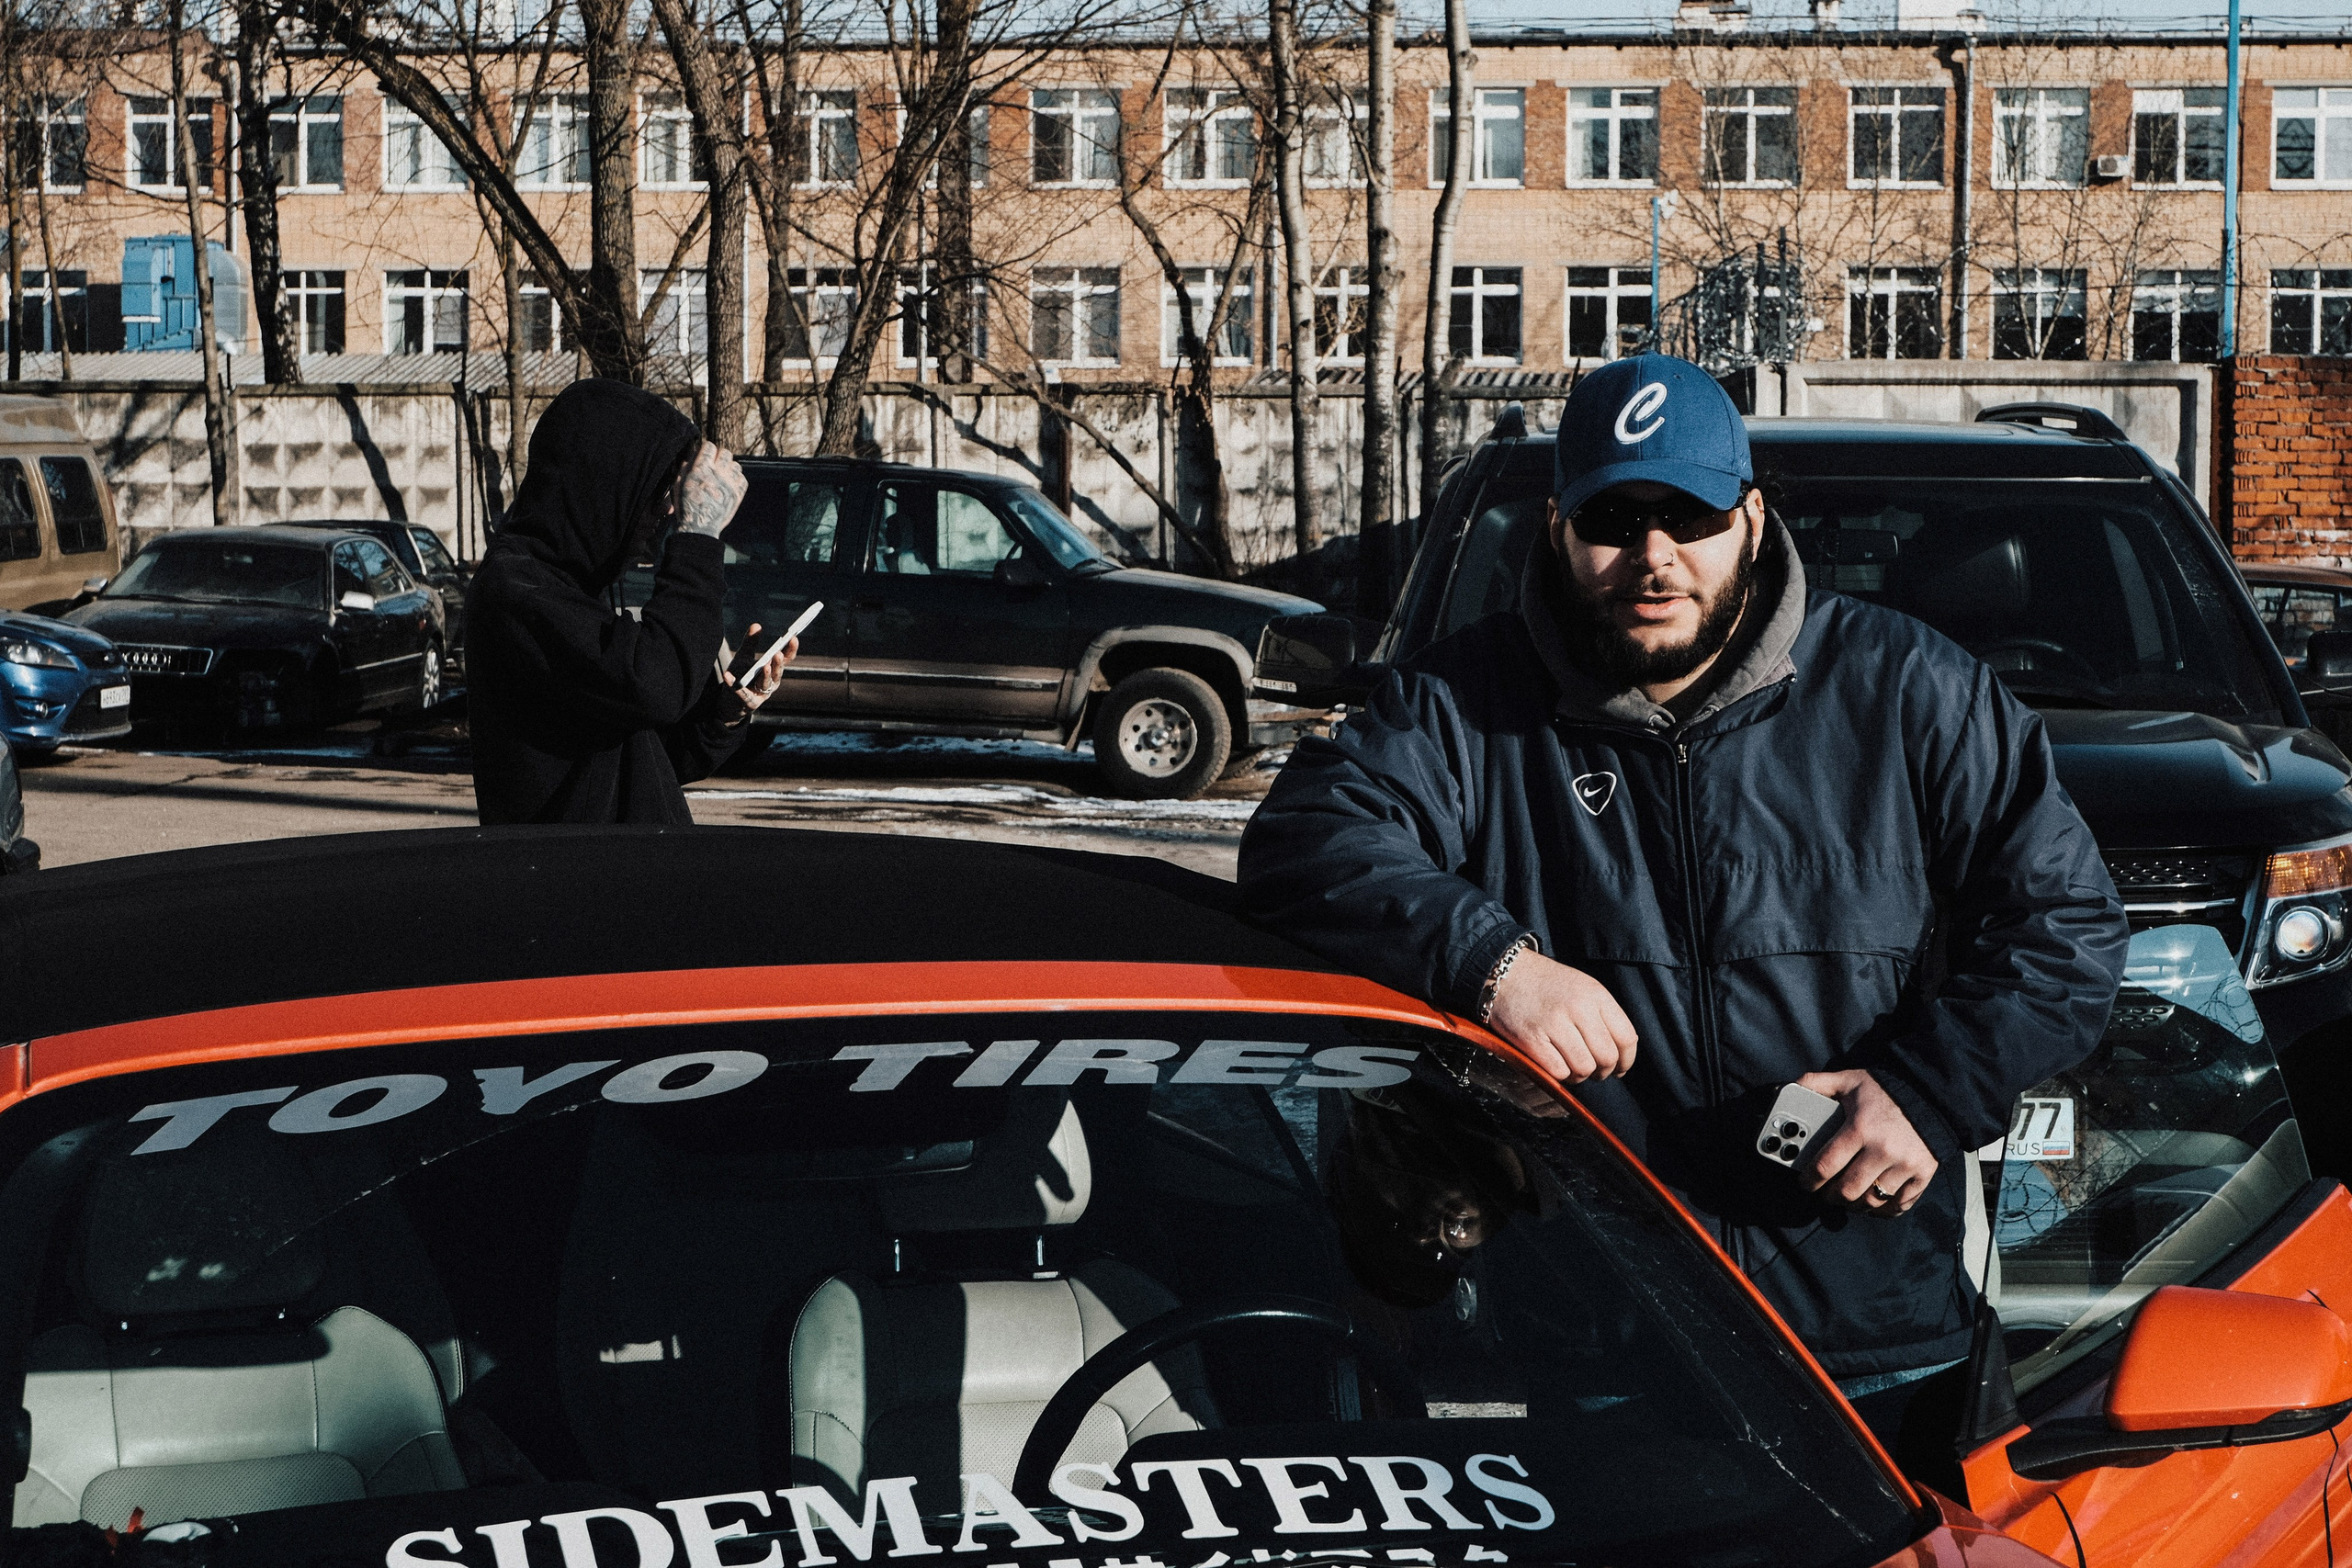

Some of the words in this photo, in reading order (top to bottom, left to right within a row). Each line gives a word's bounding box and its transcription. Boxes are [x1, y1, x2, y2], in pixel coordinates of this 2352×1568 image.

[128, 1050, 770, 1156] TOYO
[831, 1039, 1421, 1091] TIRES
[2007, 1142, 2040, 1156] RUS
[385, 1453, 1555, 1568] SIDEMASTERS
